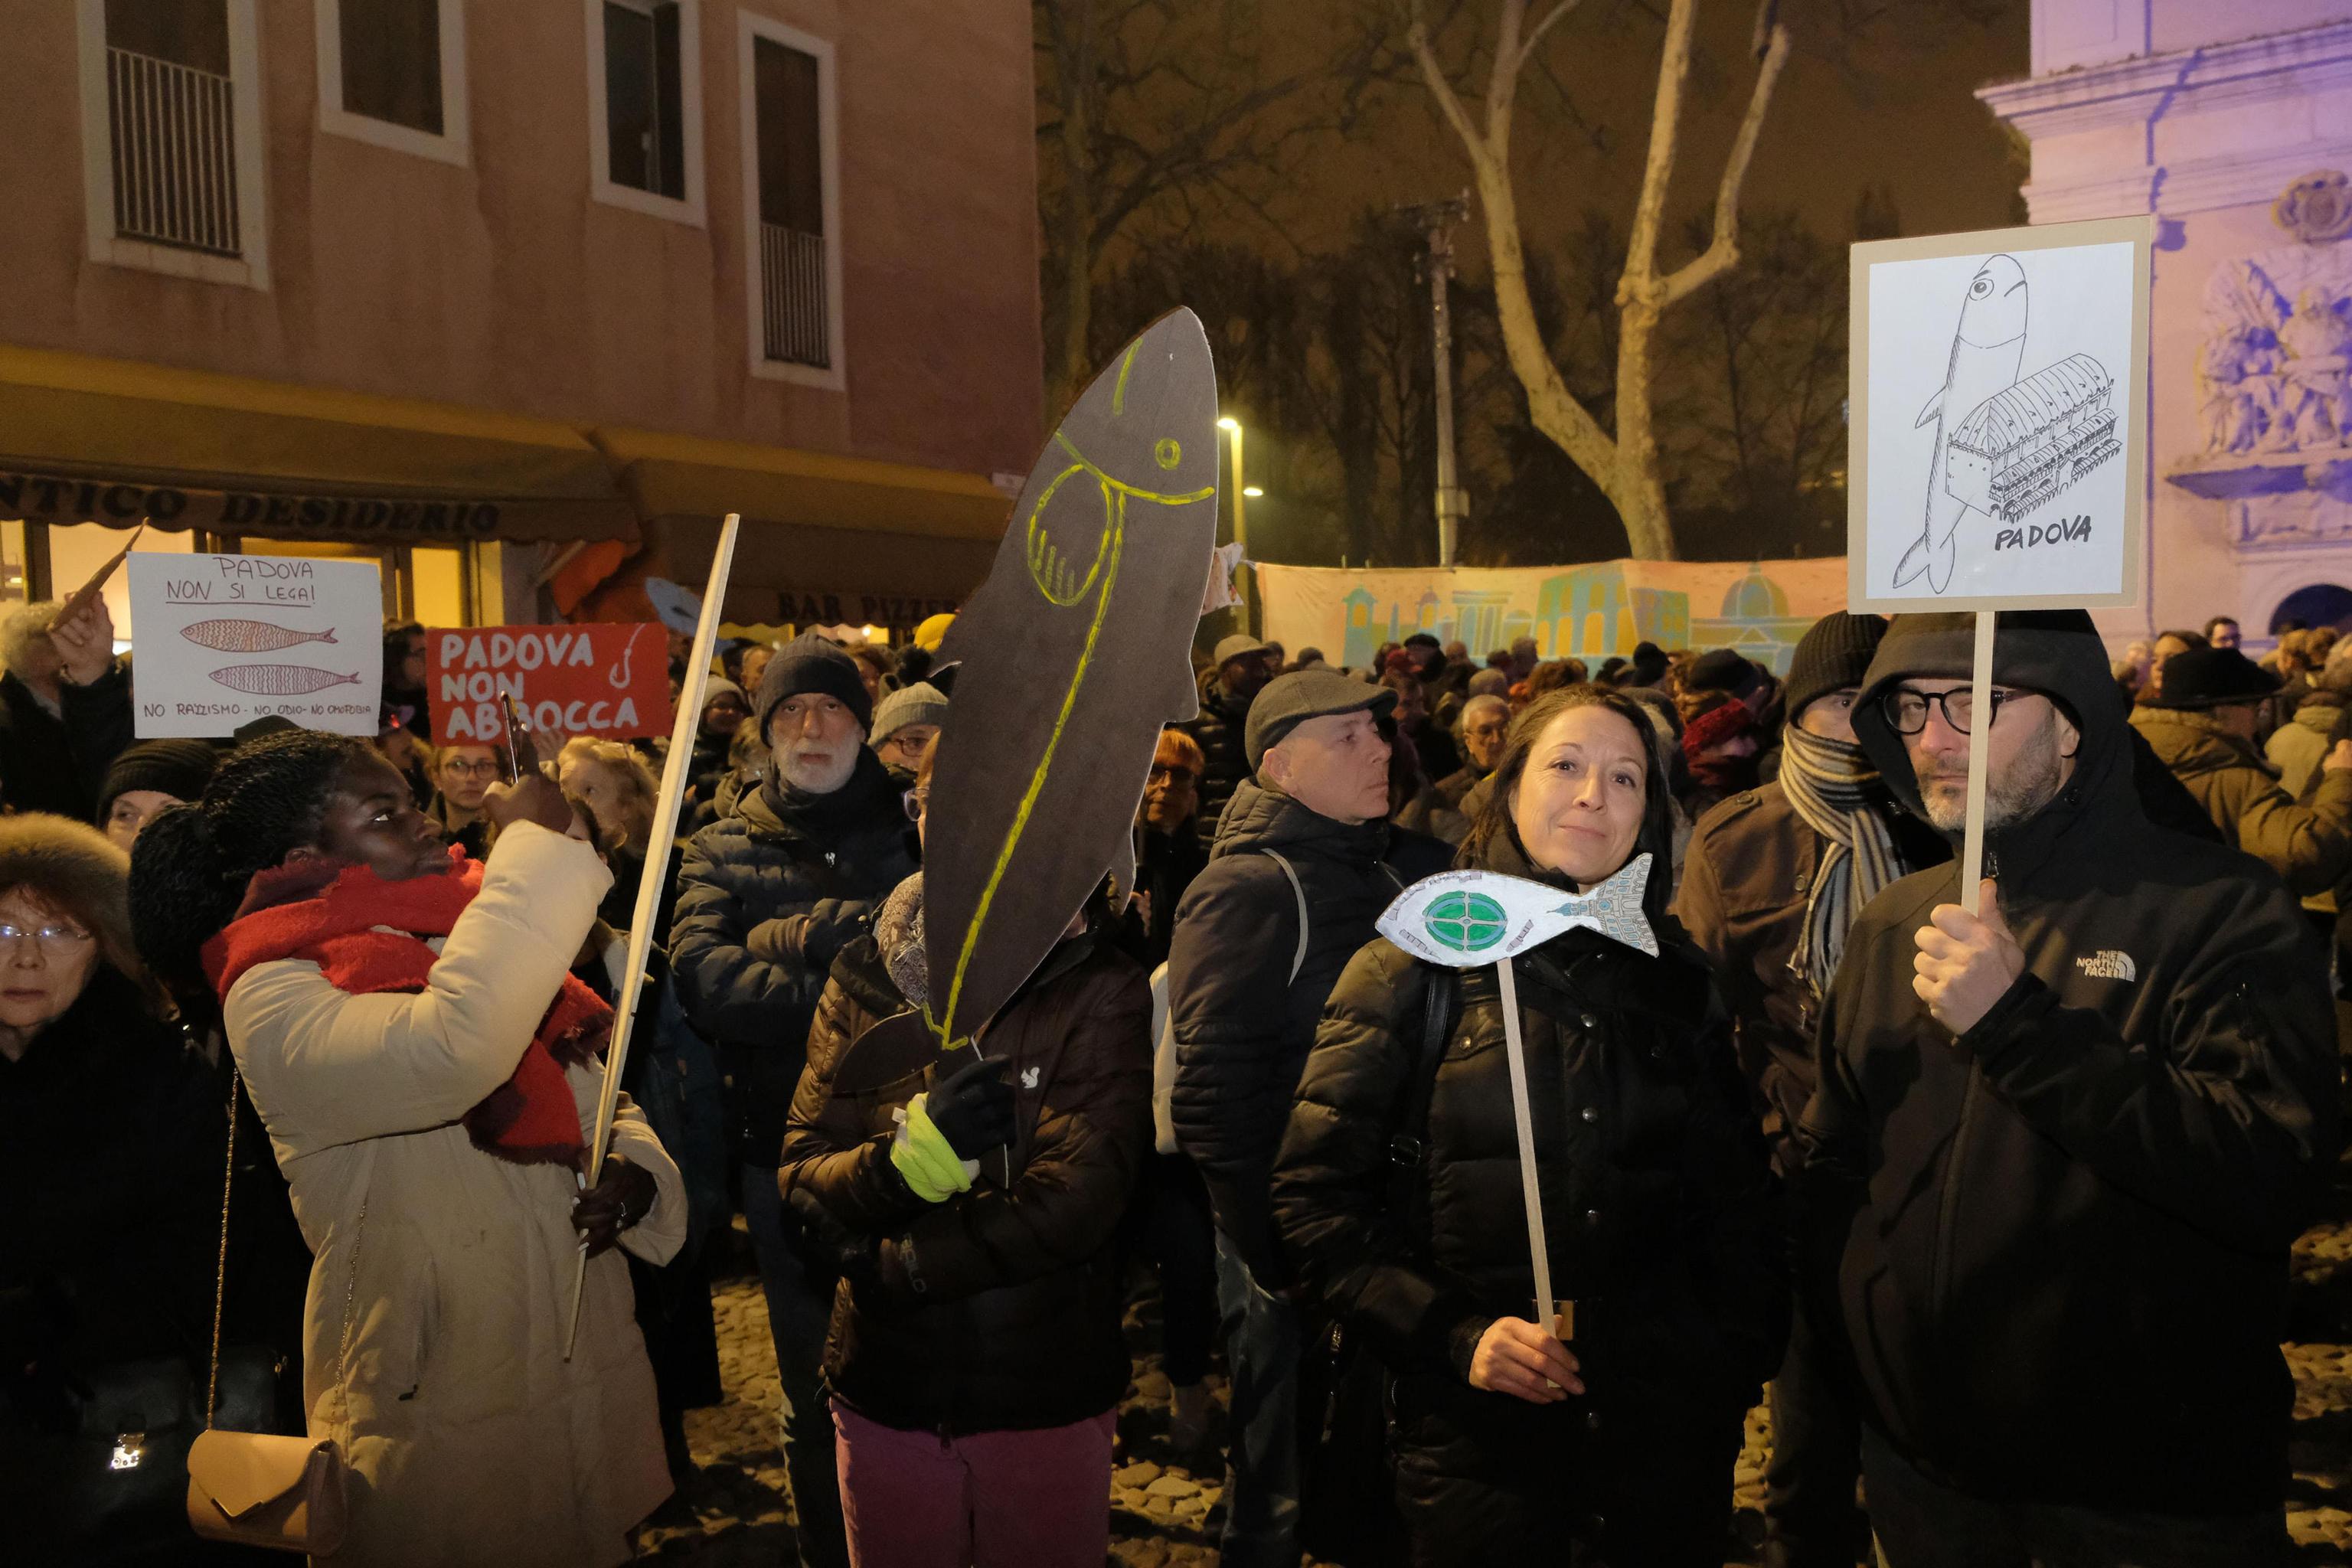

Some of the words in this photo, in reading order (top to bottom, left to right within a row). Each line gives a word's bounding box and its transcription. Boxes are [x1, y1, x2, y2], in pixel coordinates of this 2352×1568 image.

[220, 494, 500, 533] DESIDERIO
[1994, 514, 2092, 550] PADOVA
[213, 557, 313, 579] PADOVA
[166, 580, 211, 599] NON
[230, 583, 244, 599] SI
[266, 585, 315, 605] LEGA!
[778, 592, 841, 621] BAR
[440, 633, 594, 670] PADOVA
[441, 671, 524, 702] NON
[144, 704, 165, 717] NO
[176, 704, 240, 716] RAZZISMO
[254, 704, 271, 715] NO
[311, 704, 325, 715] NO
[2076, 957, 2115, 968] NORTH
[2096, 950, 2117, 959] THE
[2084, 966, 2114, 977] FACE
